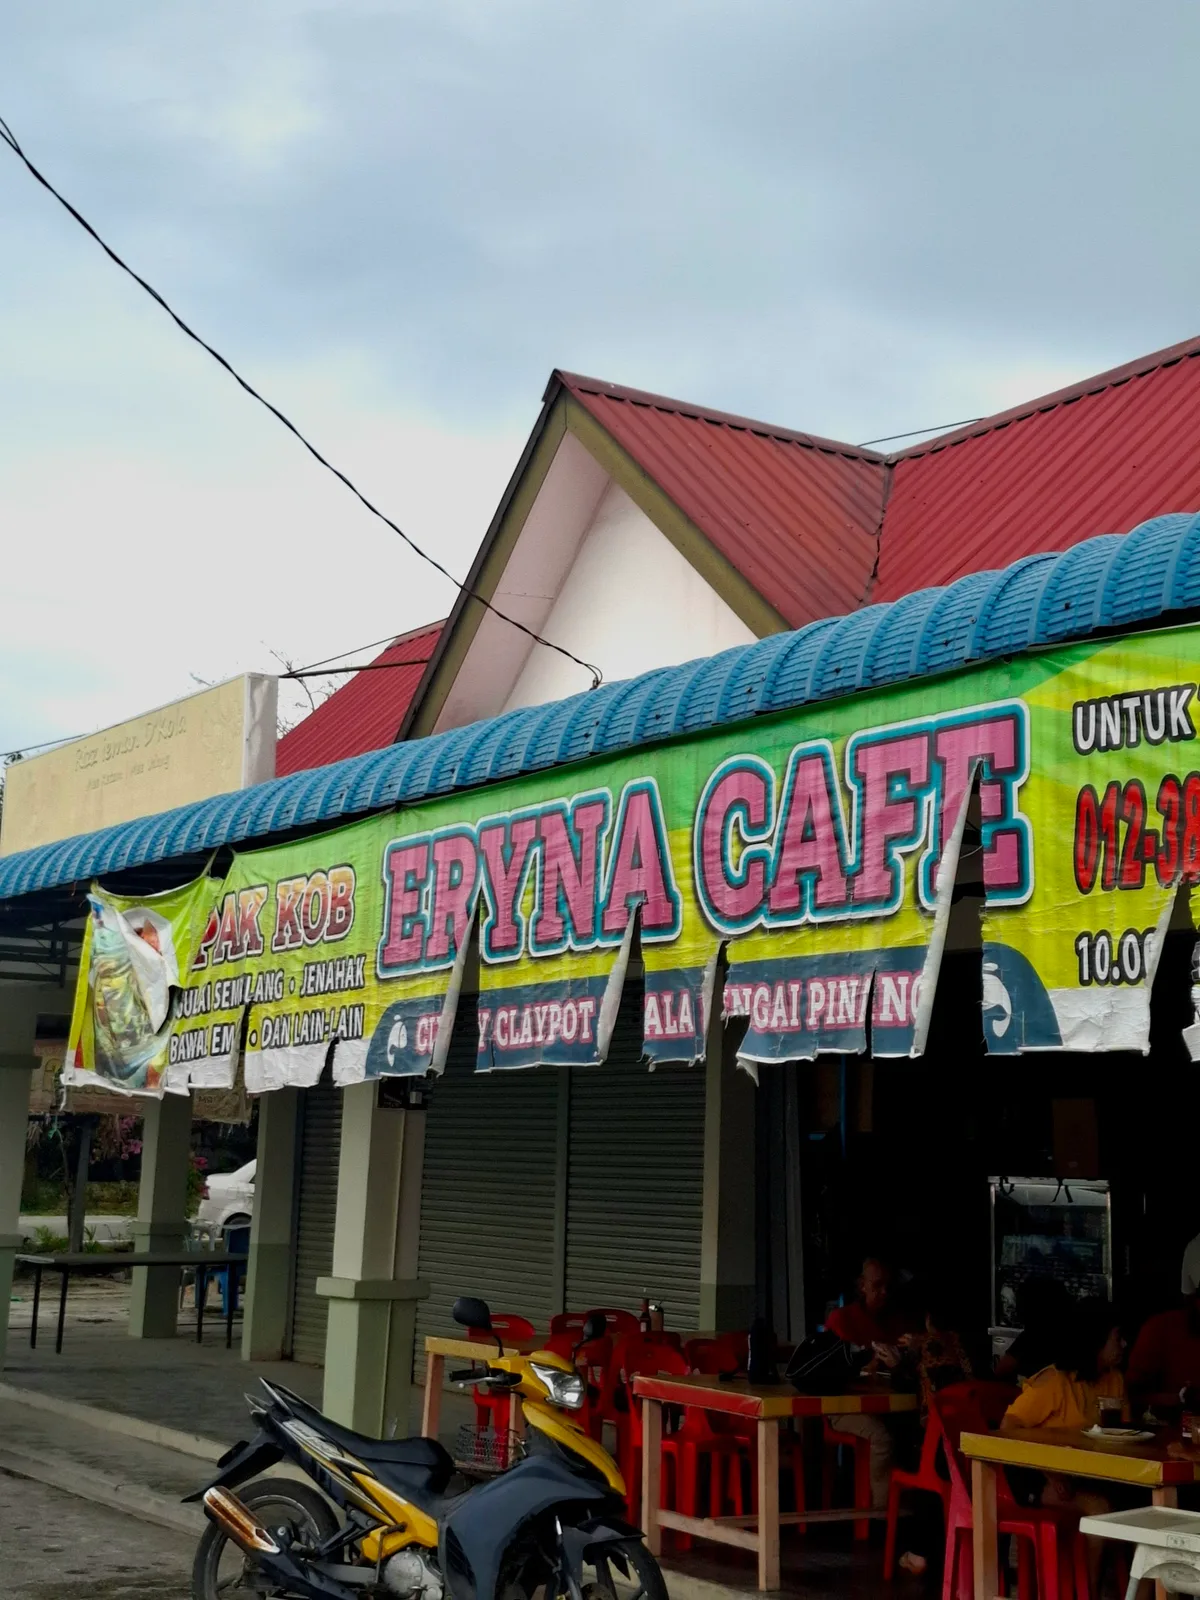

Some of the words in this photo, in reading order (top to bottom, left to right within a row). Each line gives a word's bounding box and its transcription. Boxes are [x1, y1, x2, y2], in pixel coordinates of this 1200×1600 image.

[1076, 686, 1195, 753] UNTUK
[379, 780, 679, 974] ERYNA
[698, 706, 1028, 928] CAFE
[272, 866, 355, 951] KOB
[301, 955, 364, 996] JENAHAK
[261, 1014, 291, 1049] DAN
[294, 1005, 364, 1044] LAIN-LAIN
[495, 1000, 594, 1047] CLAYPOT
